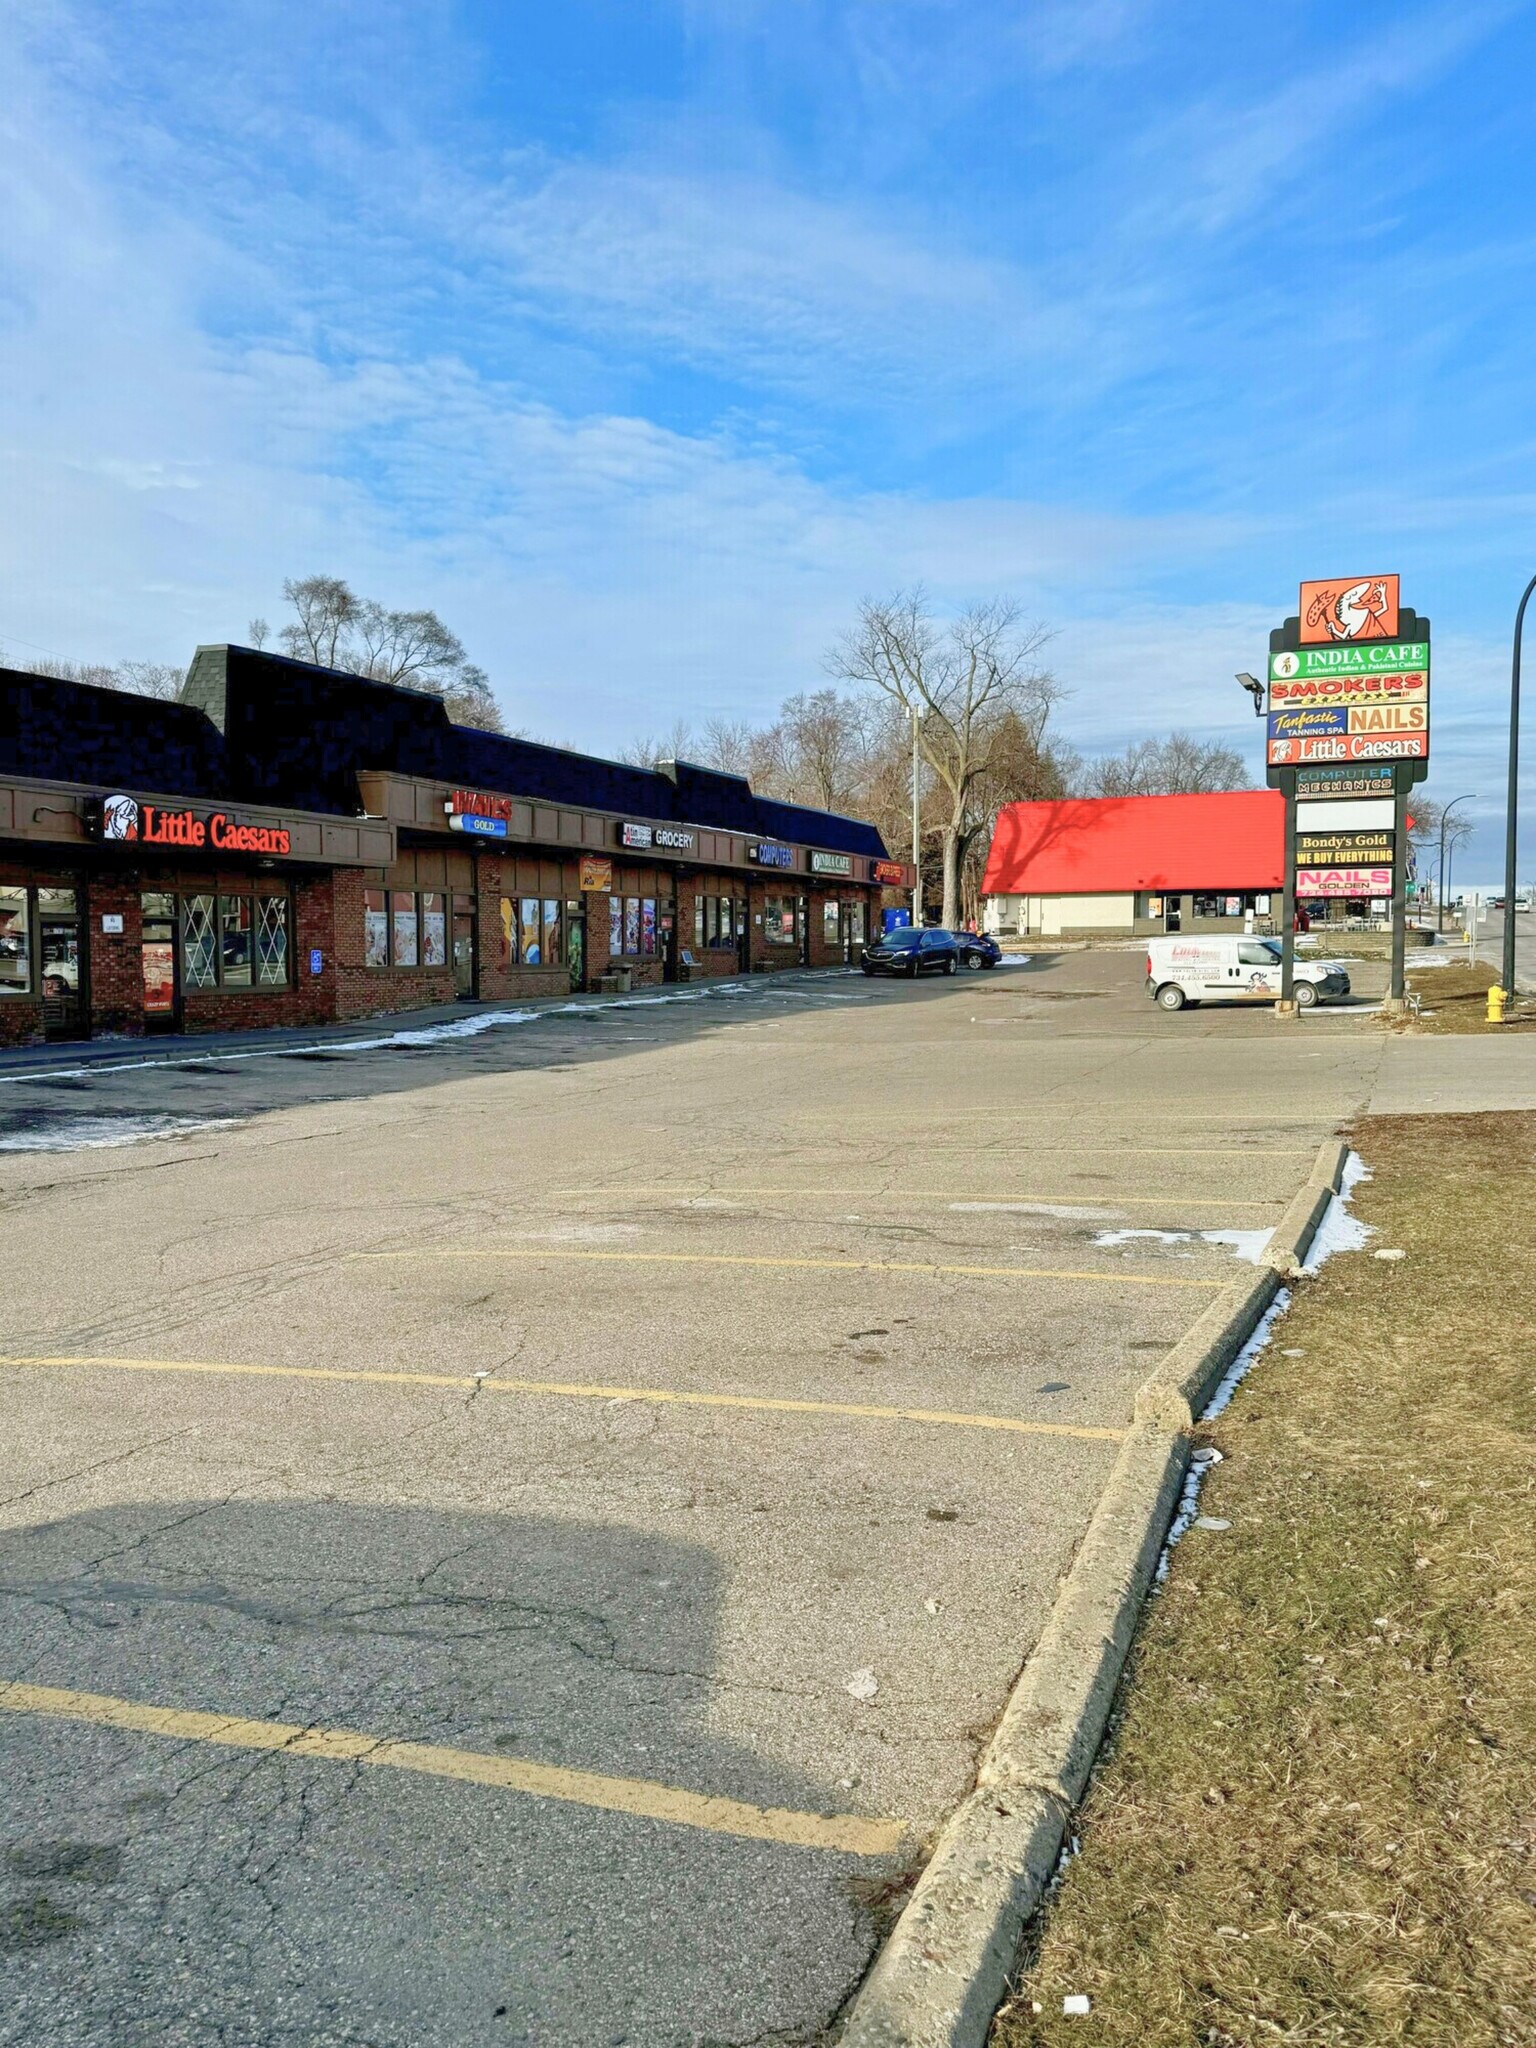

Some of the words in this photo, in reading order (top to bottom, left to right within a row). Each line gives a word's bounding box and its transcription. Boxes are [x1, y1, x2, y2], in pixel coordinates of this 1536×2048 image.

[1306, 649, 1364, 667] INDIA
[1369, 645, 1423, 662] CAFE
[1271, 675, 1423, 699] SMOKERS
[1300, 691, 1390, 706] EXPRESS
[1273, 710, 1342, 734] Tanfastic
[1351, 707, 1424, 731] NAILS
[1287, 727, 1325, 736] TANNING
[1327, 726, 1345, 735] SPA
[1298, 737, 1346, 760] Little
[1351, 736, 1421, 759] Caesars
[1298, 768, 1392, 782] COMPUTER
[142, 806, 205, 847] Little
[210, 813, 291, 854] Caesars
[474, 819, 496, 831] GOLD
[655, 829, 694, 849] GROCERY
[1302, 836, 1352, 850] Bondy's
[1355, 834, 1387, 846] Gold
[759, 844, 794, 868] COMPUTERS
[1297, 852, 1313, 864] WE
[1315, 851, 1332, 863] BUY
[1335, 849, 1393, 862] EVERYTHING
[1300, 870, 1390, 886] NAILS
[1318, 882, 1370, 890] GOLDEN
